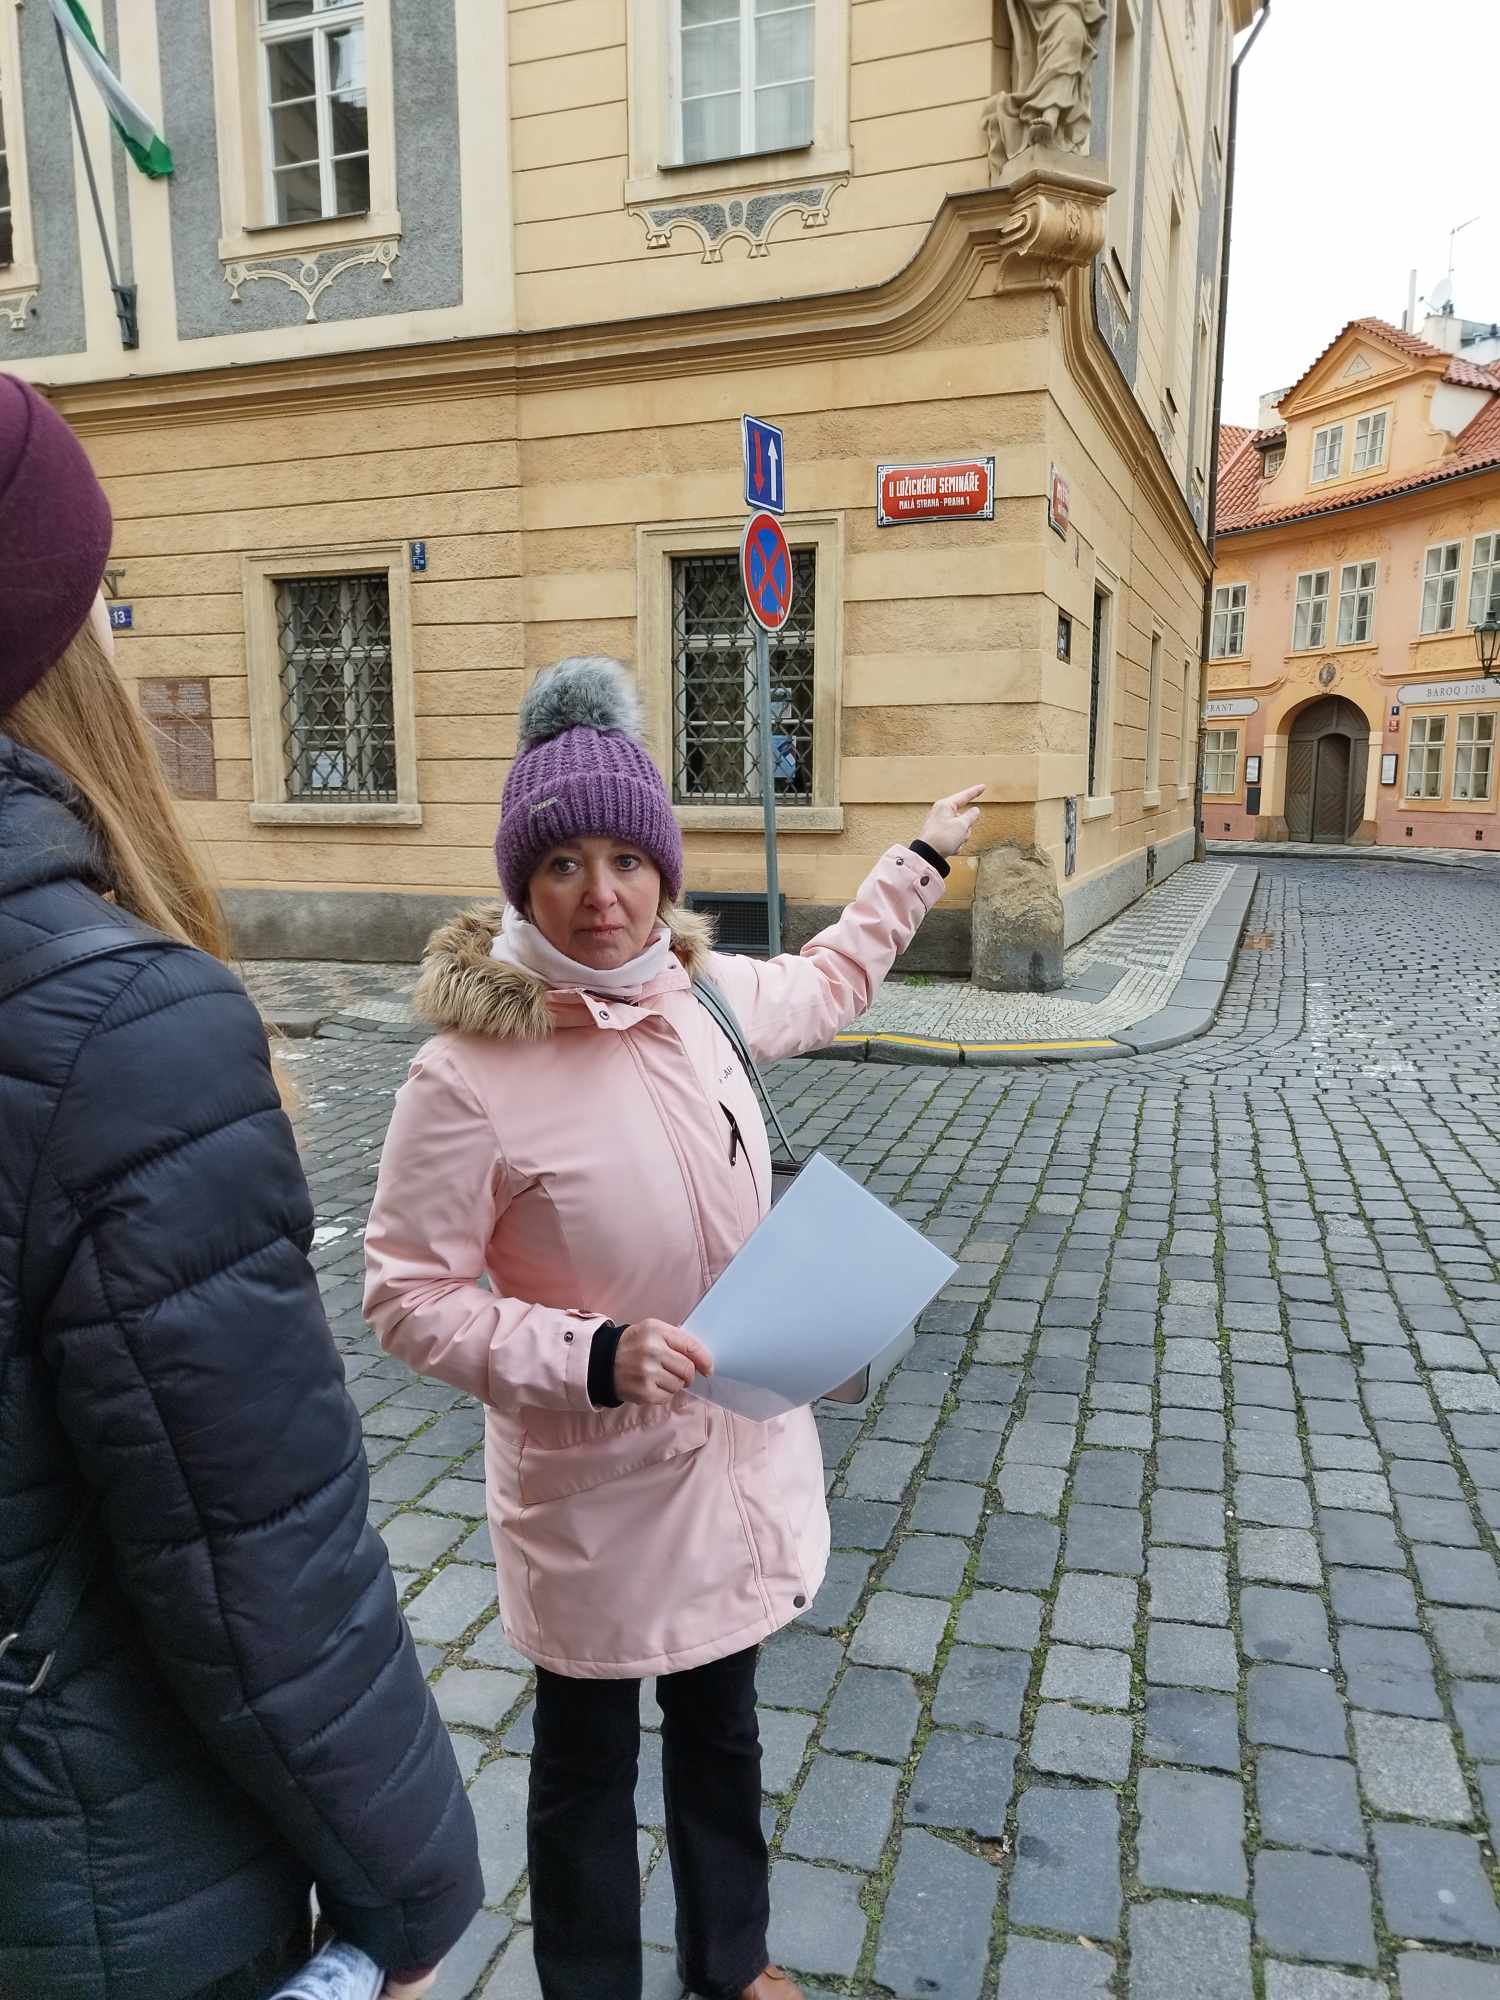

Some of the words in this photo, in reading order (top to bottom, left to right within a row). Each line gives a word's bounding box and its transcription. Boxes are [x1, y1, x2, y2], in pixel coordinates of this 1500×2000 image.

[889, 481, 894, 497] U
[896, 475, 937, 496] LUŽICKÉHO
[939, 472, 980, 493] SEMINÁŘE
[899, 499, 915, 510] MALÁ
[916, 498, 939, 509] STRANA
[944, 497, 965, 507] PRAHA
[966, 496, 970, 505] 1
[113, 610, 126, 625] 13
[1427, 686, 1461, 697] BAROQ
[1208, 703, 1234, 713] RANT
